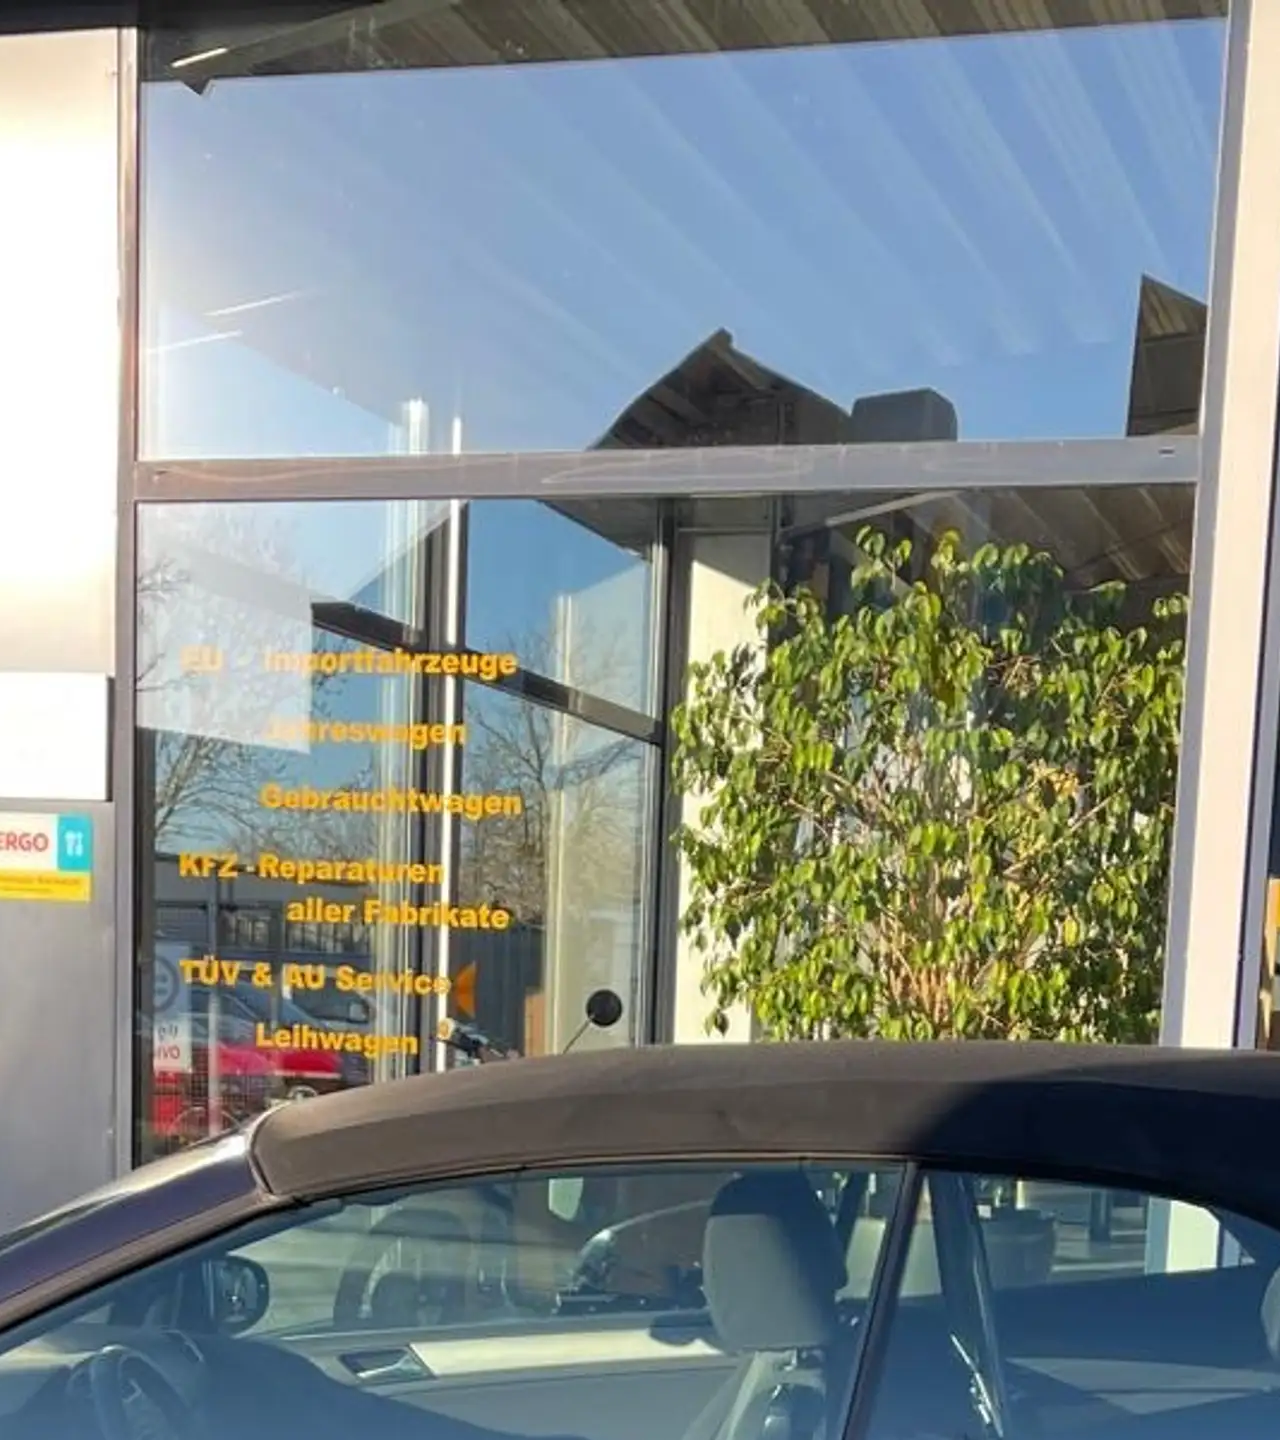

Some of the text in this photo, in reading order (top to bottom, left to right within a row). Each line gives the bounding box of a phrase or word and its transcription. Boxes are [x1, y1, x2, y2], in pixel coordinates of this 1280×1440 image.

[180, 647, 517, 679] EU Importfahrzeuge
[264, 720, 467, 749] Jahreswagen
[259, 784, 522, 821] Gebrauchtwagen
[179, 853, 239, 878] KFZ
[259, 854, 447, 885] Reparaturen
[286, 898, 511, 930] aller Fabrikate
[179, 956, 453, 998] TÜV & AU Service
[255, 1022, 419, 1059] Leihwagen
